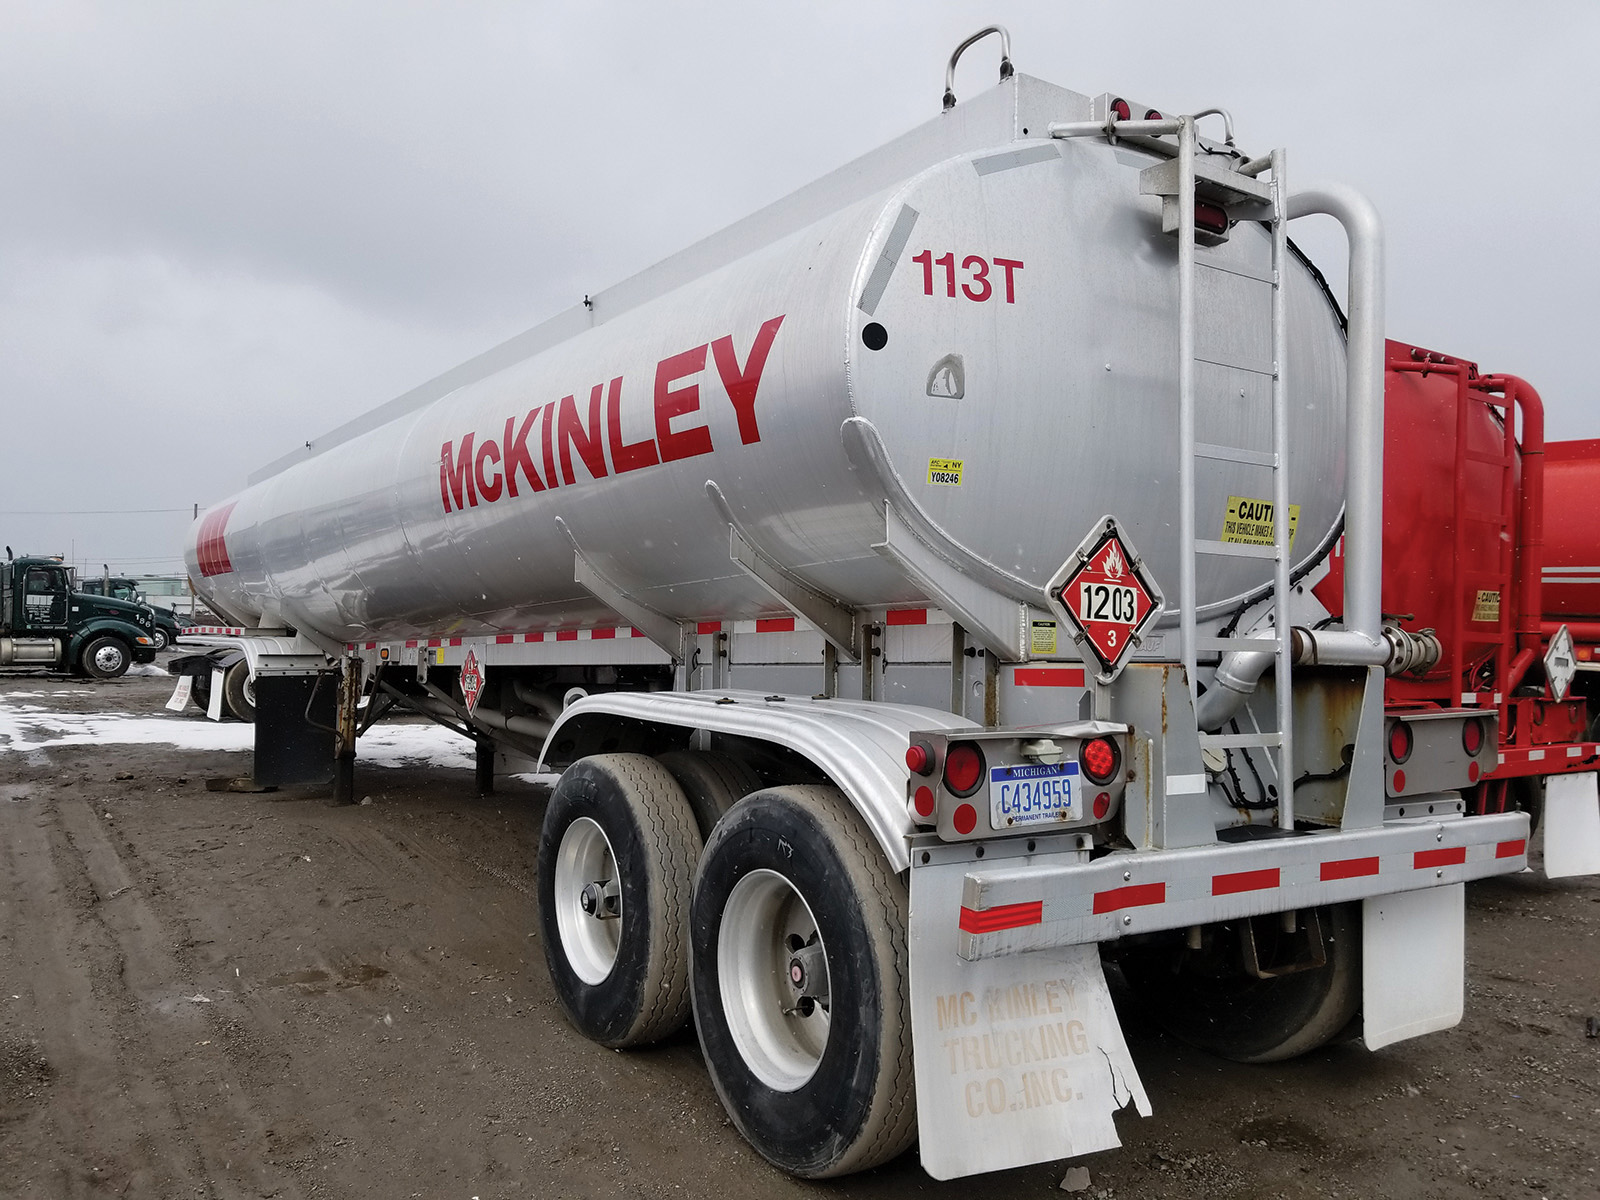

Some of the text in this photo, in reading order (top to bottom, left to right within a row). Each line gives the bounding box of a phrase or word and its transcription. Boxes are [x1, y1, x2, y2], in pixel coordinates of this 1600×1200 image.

[912, 249, 1024, 304] 113T
[439, 313, 787, 514] McKINLEY
[931, 471, 959, 484] Y08246
[1239, 501, 1289, 522] CAUTI
[1083, 584, 1135, 623] 1203
[135, 613, 151, 629] 186
[1107, 630, 1117, 647] 3
[1013, 765, 1059, 778] MICHIGAN
[1001, 778, 1072, 814] C434959
[1012, 813, 1042, 823] PERMANENT
[936, 991, 978, 1031] MC
[943, 1019, 1090, 1075] TRUCKING
